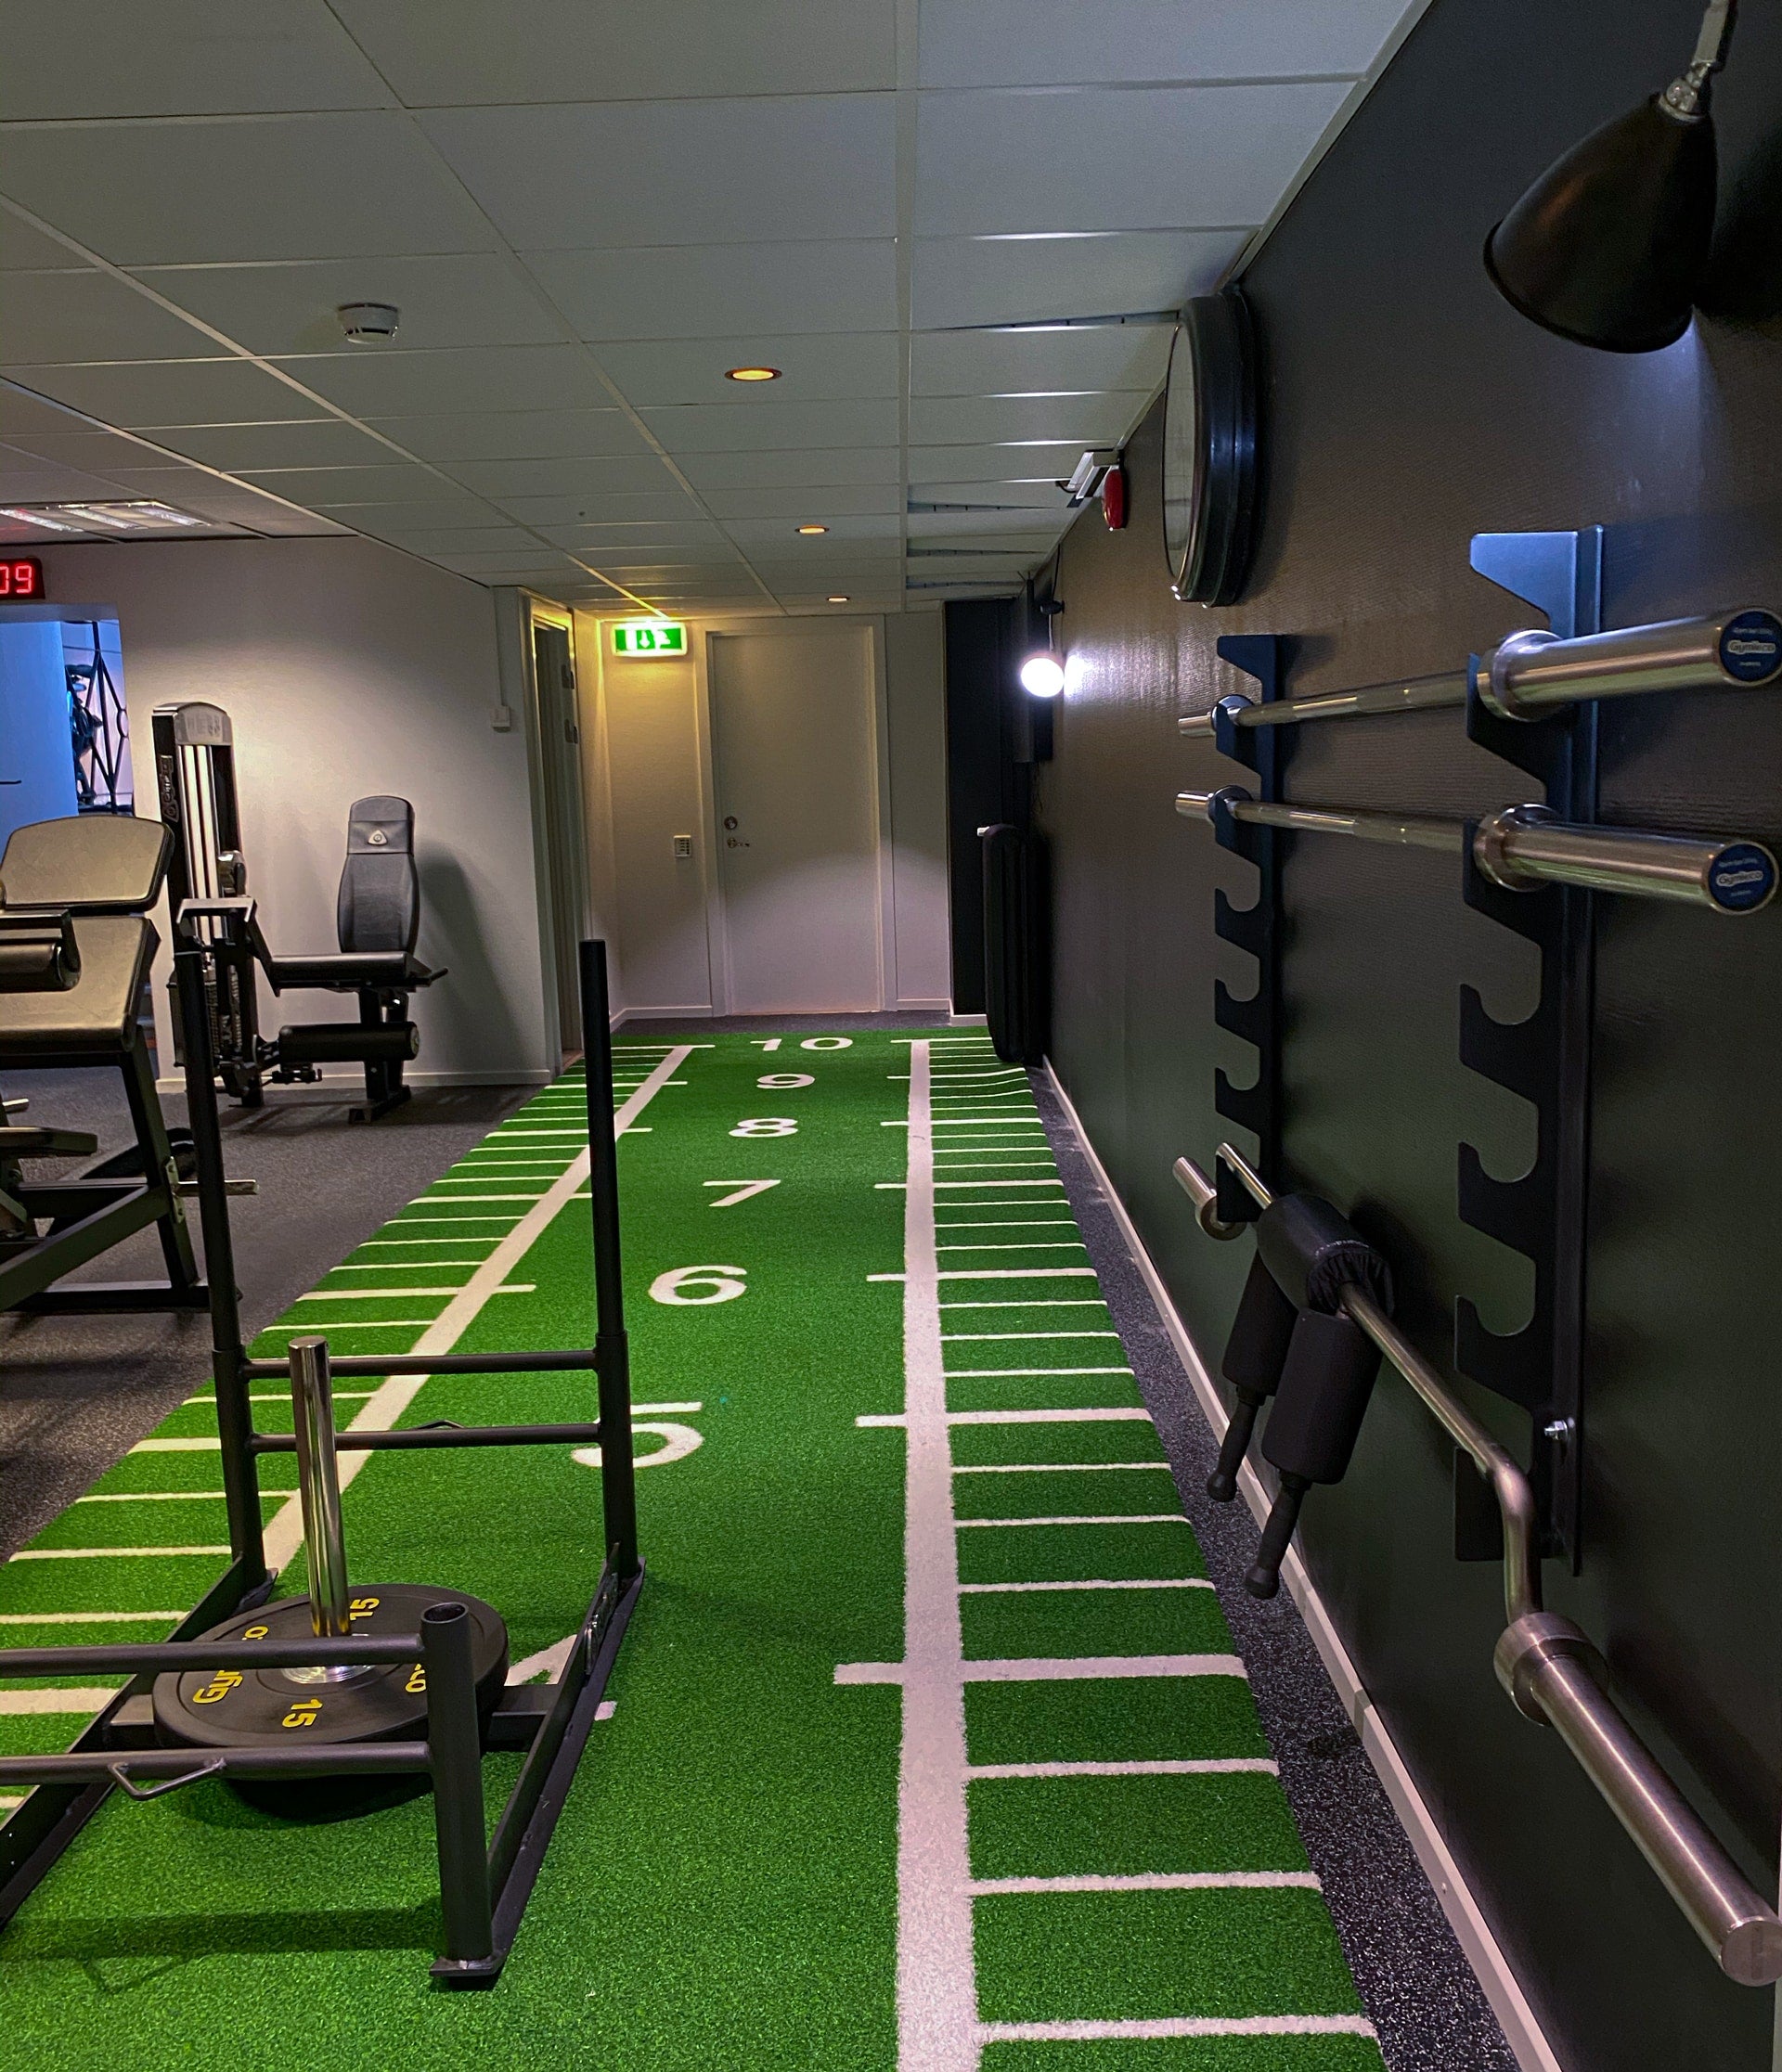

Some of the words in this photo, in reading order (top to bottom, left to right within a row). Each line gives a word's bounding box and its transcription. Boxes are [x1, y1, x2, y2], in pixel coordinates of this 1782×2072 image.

[750, 1037, 853, 1050] 10
[756, 1074, 815, 1088] 9
[729, 1118, 798, 1138] 8
[703, 1179, 781, 1206] 7
[649, 1265, 747, 1305] 6
[572, 1402, 704, 1468] 5
[349, 1597, 381, 1621] 15
[281, 1698, 324, 1728] 15
